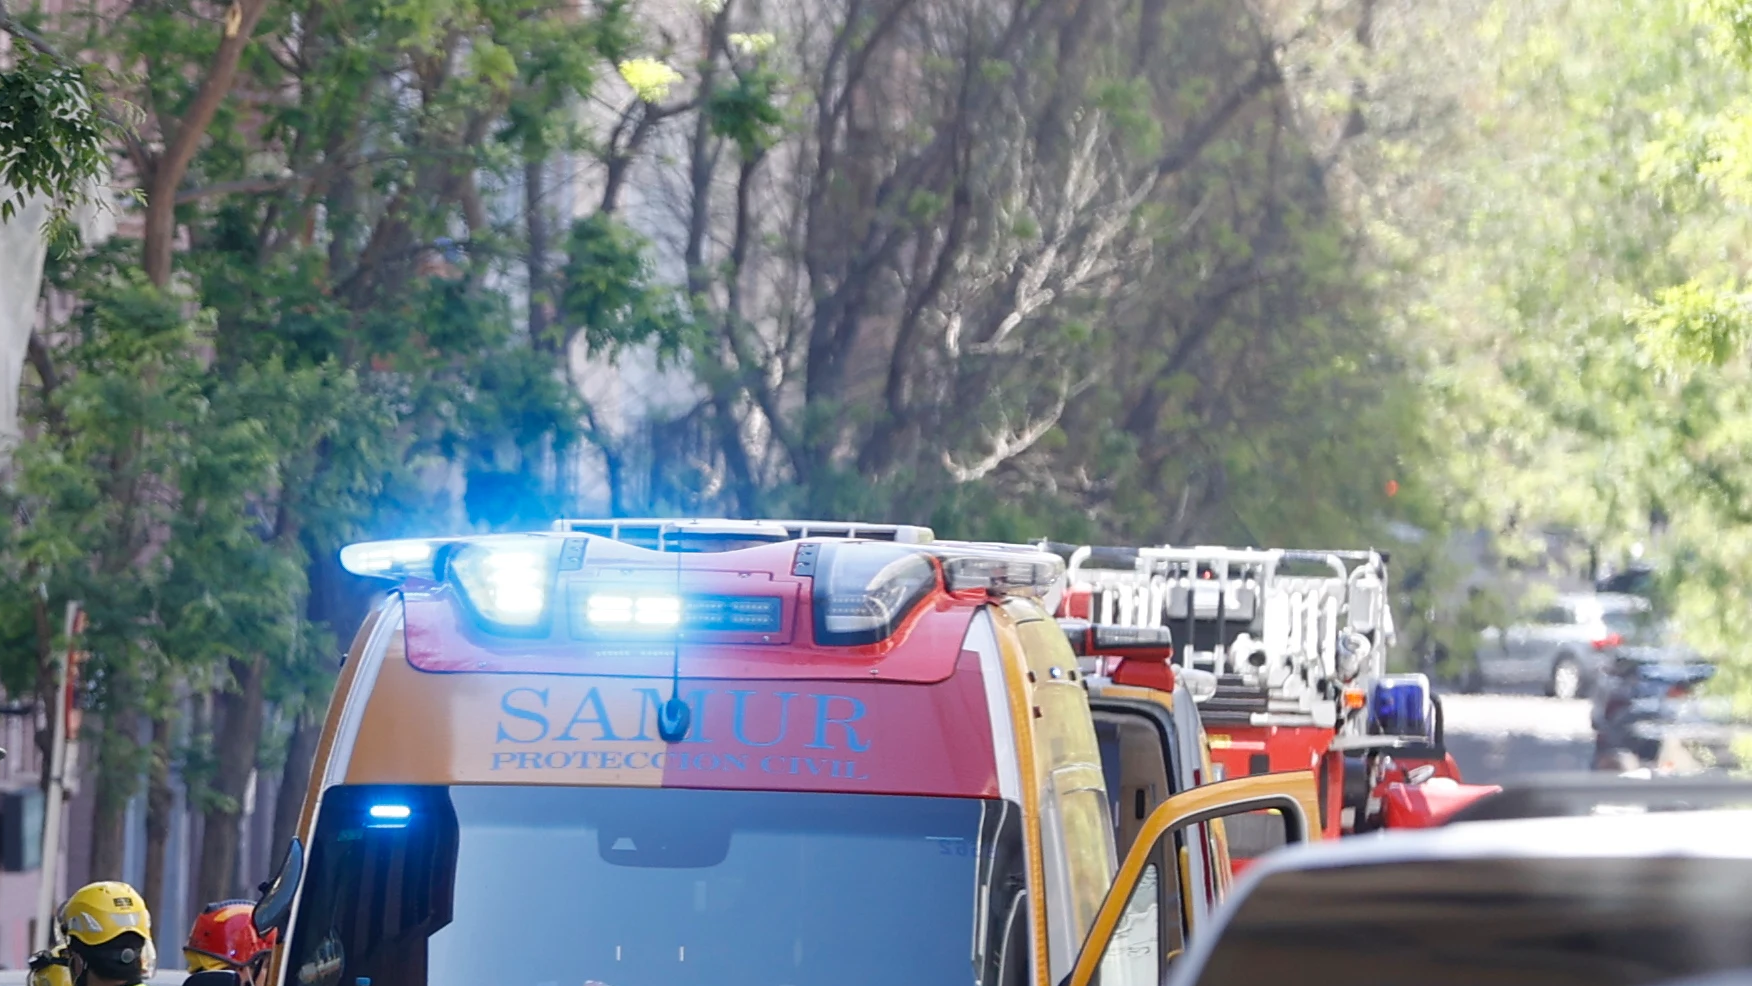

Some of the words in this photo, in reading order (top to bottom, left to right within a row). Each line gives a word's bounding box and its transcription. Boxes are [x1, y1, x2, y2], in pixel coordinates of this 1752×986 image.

[495, 686, 872, 753] SAMUR
[489, 750, 749, 772] PROTECCION
[759, 755, 870, 781] CIVIL
